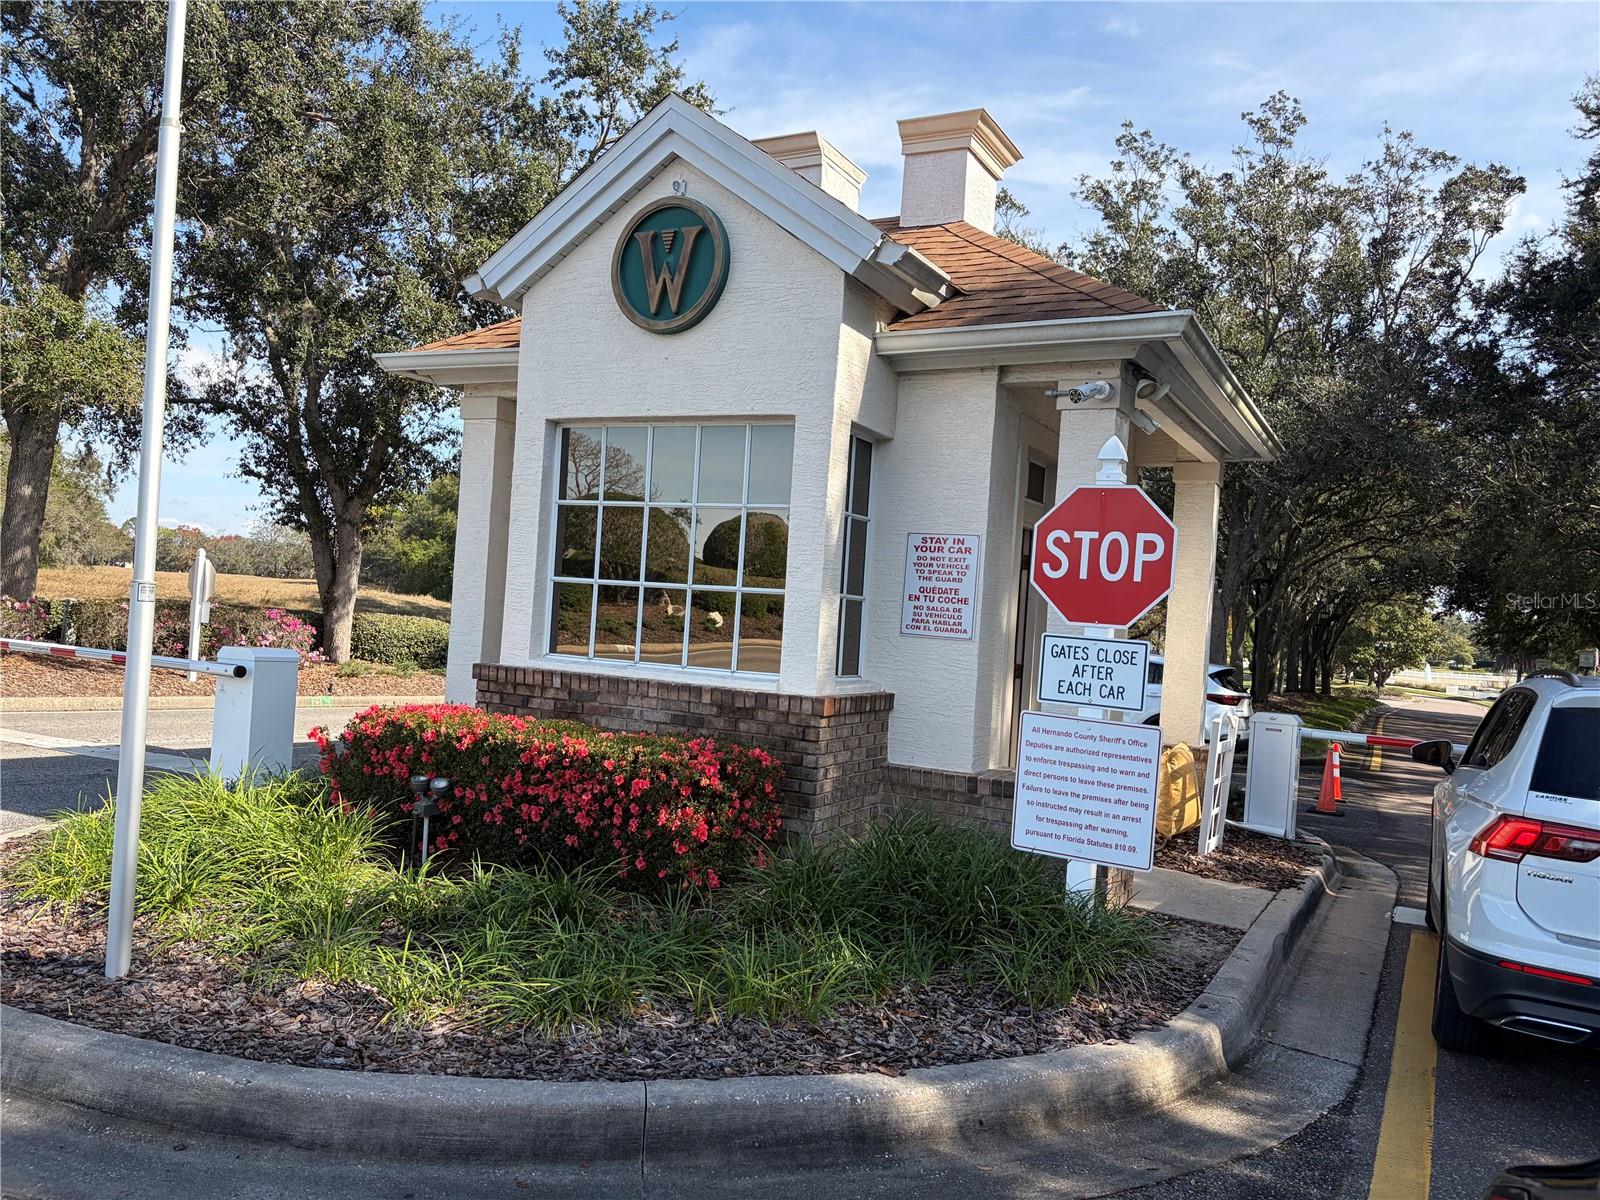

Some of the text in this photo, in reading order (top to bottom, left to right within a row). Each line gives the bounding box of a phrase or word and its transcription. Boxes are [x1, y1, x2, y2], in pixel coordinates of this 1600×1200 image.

[634, 225, 703, 316] W
[914, 545, 972, 554] YOUR CAR
[921, 537, 949, 545] STAY
[1042, 529, 1165, 582] STOP
[908, 594, 969, 605] EN TU COCHE
[919, 585, 960, 596] QUÉDATE
[932, 619, 963, 627] HABLAR
[934, 626, 968, 634] GUARDIA
[1051, 644, 1138, 665] GATES CLOSE
[1072, 664, 1114, 681] AFTER
[1058, 680, 1126, 700] EACH CAR
[1042, 728, 1073, 737] Hernando
[1074, 732, 1097, 742] County
[1099, 734, 1126, 745] Sheriff's
[1128, 739, 1148, 748] Office
[1025, 740, 1053, 751] Deputies
[1066, 746, 1100, 756] authorized
[1101, 753, 1153, 764] representatives
[1033, 756, 1057, 765] enforce
[1058, 760, 1095, 772] trespassing
[1097, 764, 1110, 773] and
[1137, 770, 1150, 779] and
[1023, 769, 1042, 778] direct
[1043, 773, 1069, 783] persons
[1078, 778, 1096, 786] leave
[1096, 780, 1115, 788] these
[1116, 785, 1149, 795] premises.
[1022, 783, 1043, 793] Failure
[1052, 788, 1069, 797] leave
[1070, 790, 1081, 799] the
[1082, 793, 1112, 804] premises
[1113, 797, 1128, 806] after
[1130, 800, 1150, 811] being
[1035, 801, 1067, 811] instructed
[1068, 806, 1083, 814] may
[1083, 808, 1103, 818] result
[1121, 815, 1142, 823] arrest
[1035, 814, 1045, 822] for
[1046, 818, 1083, 830] trespassing
[1084, 823, 1099, 832] after
[1025, 828, 1053, 839] pursuant
[1062, 834, 1085, 845] Florida
[1086, 838, 1113, 849] Statutes
[1114, 843, 1138, 854] 810.09.
